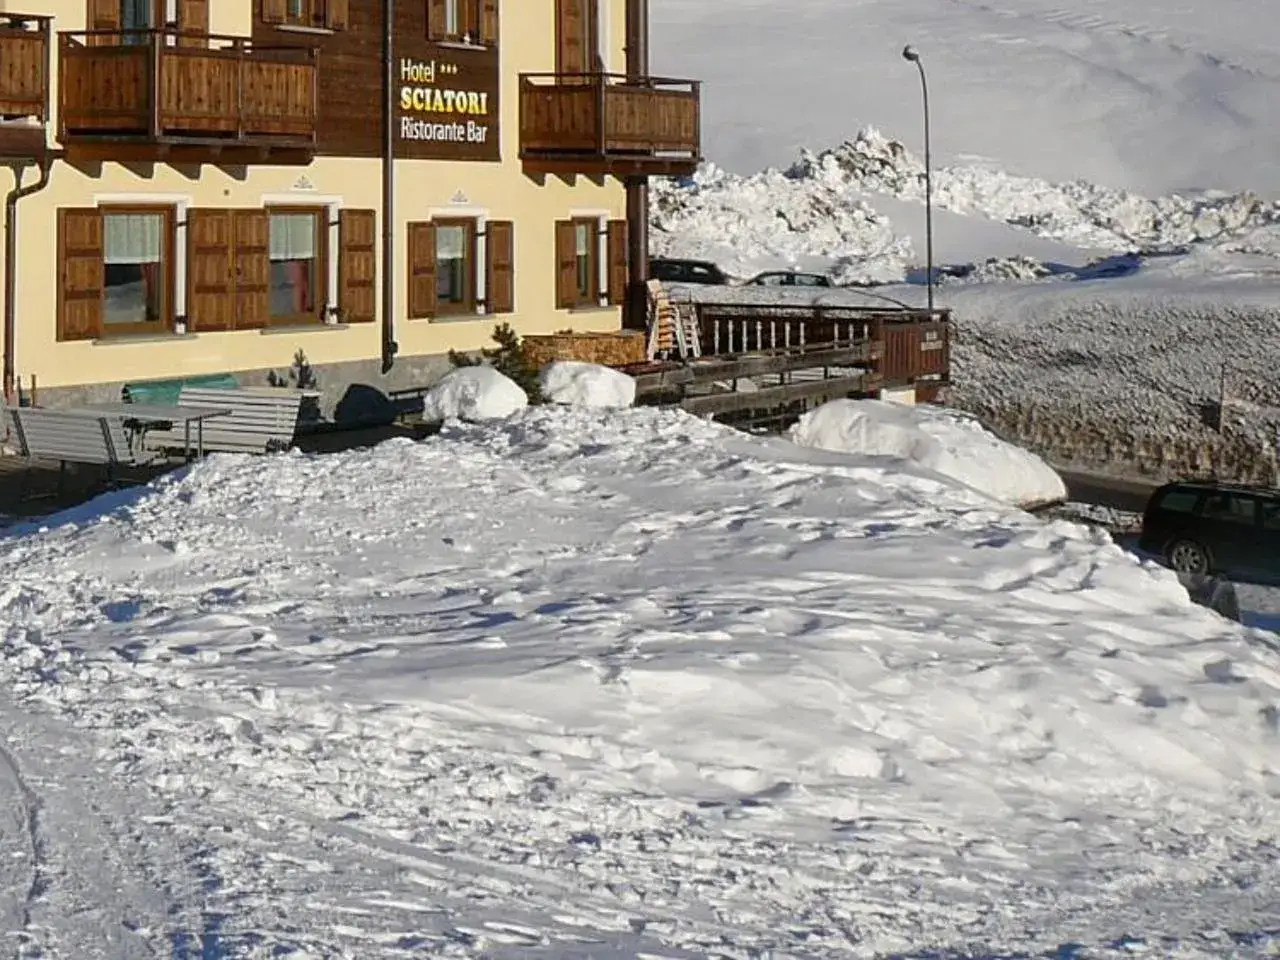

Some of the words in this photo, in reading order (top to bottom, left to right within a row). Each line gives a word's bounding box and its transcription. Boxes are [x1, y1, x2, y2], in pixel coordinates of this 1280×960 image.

[400, 58, 435, 83] Hotel
[400, 86, 488, 114] SCIATORI
[400, 116, 465, 142] Ristorante
[466, 120, 488, 143] Bar
